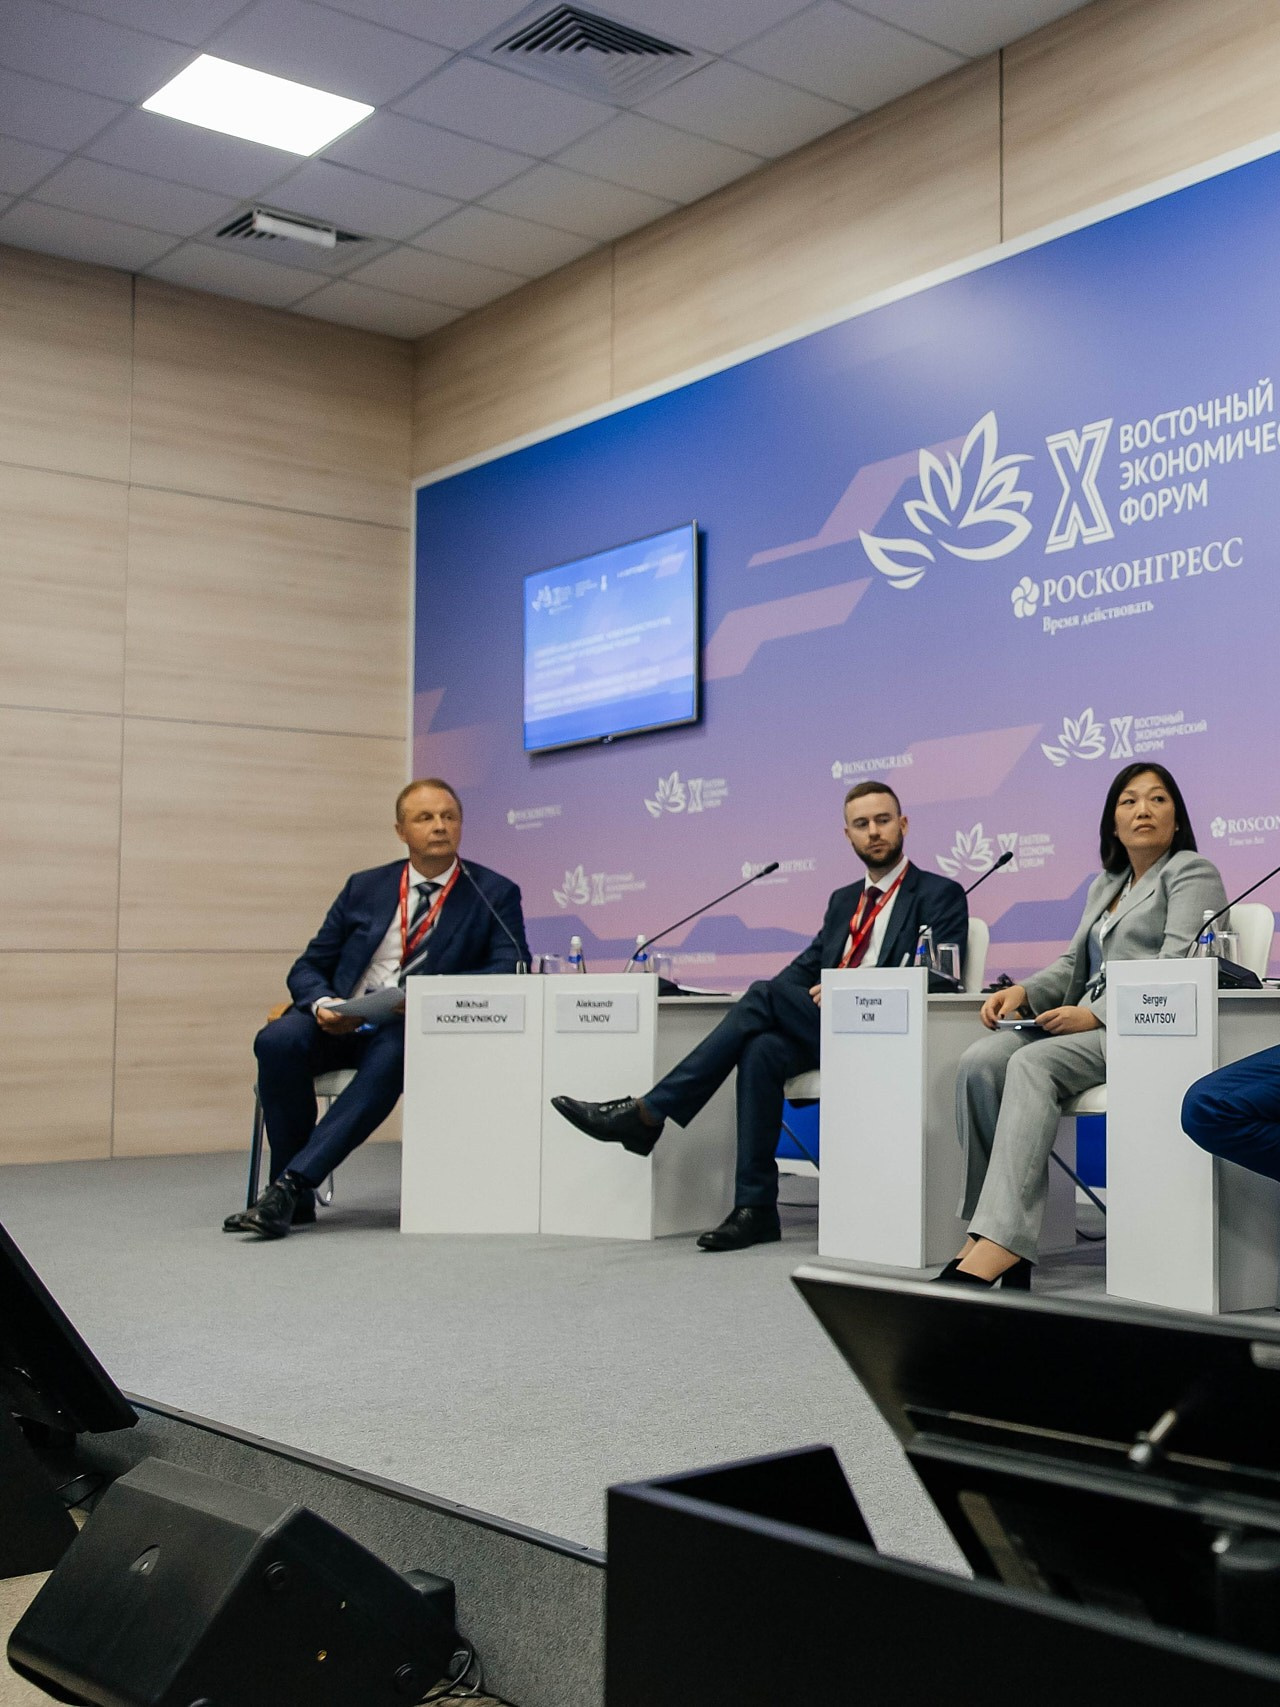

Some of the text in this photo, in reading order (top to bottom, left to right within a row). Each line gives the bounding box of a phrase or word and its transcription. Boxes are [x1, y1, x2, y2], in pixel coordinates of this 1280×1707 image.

[1119, 378, 1274, 455] ВОСТОЧНЫЙ
[1119, 478, 1208, 526] ФОРУМ
[1042, 537, 1243, 607] РОСКОНГРЕСС
[1043, 600, 1155, 635] Время действовать
[456, 1000, 489, 1009] Mikhail
[576, 1000, 613, 1009] Aleksandr
[855, 996, 882, 1008] Tatyana
[1142, 994, 1168, 1008] Sergey
[436, 1014, 508, 1024] KOZHEVNIKOV
[579, 1014, 610, 1023] VILINOV
[862, 1013, 875, 1022] KIM
[1134, 1013, 1177, 1025] KRAVTSOV
